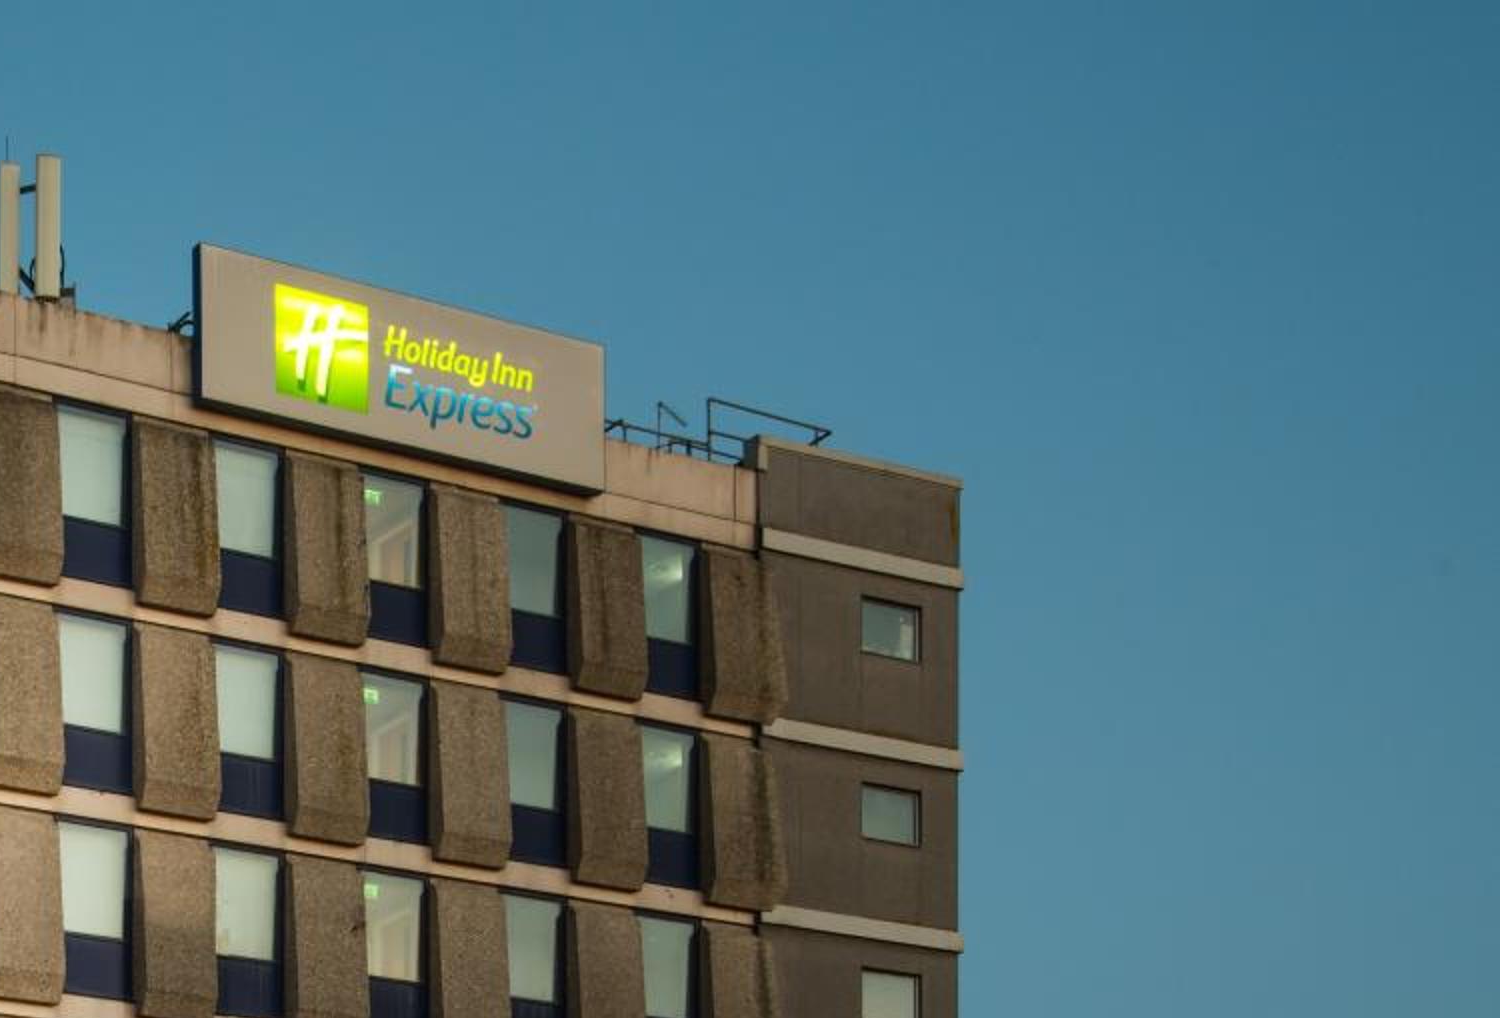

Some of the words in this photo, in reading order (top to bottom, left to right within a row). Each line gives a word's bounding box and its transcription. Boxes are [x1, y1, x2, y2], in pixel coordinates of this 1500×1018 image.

[384, 324, 488, 387] Holiday
[491, 351, 533, 392] Inn
[385, 364, 533, 439] Express
